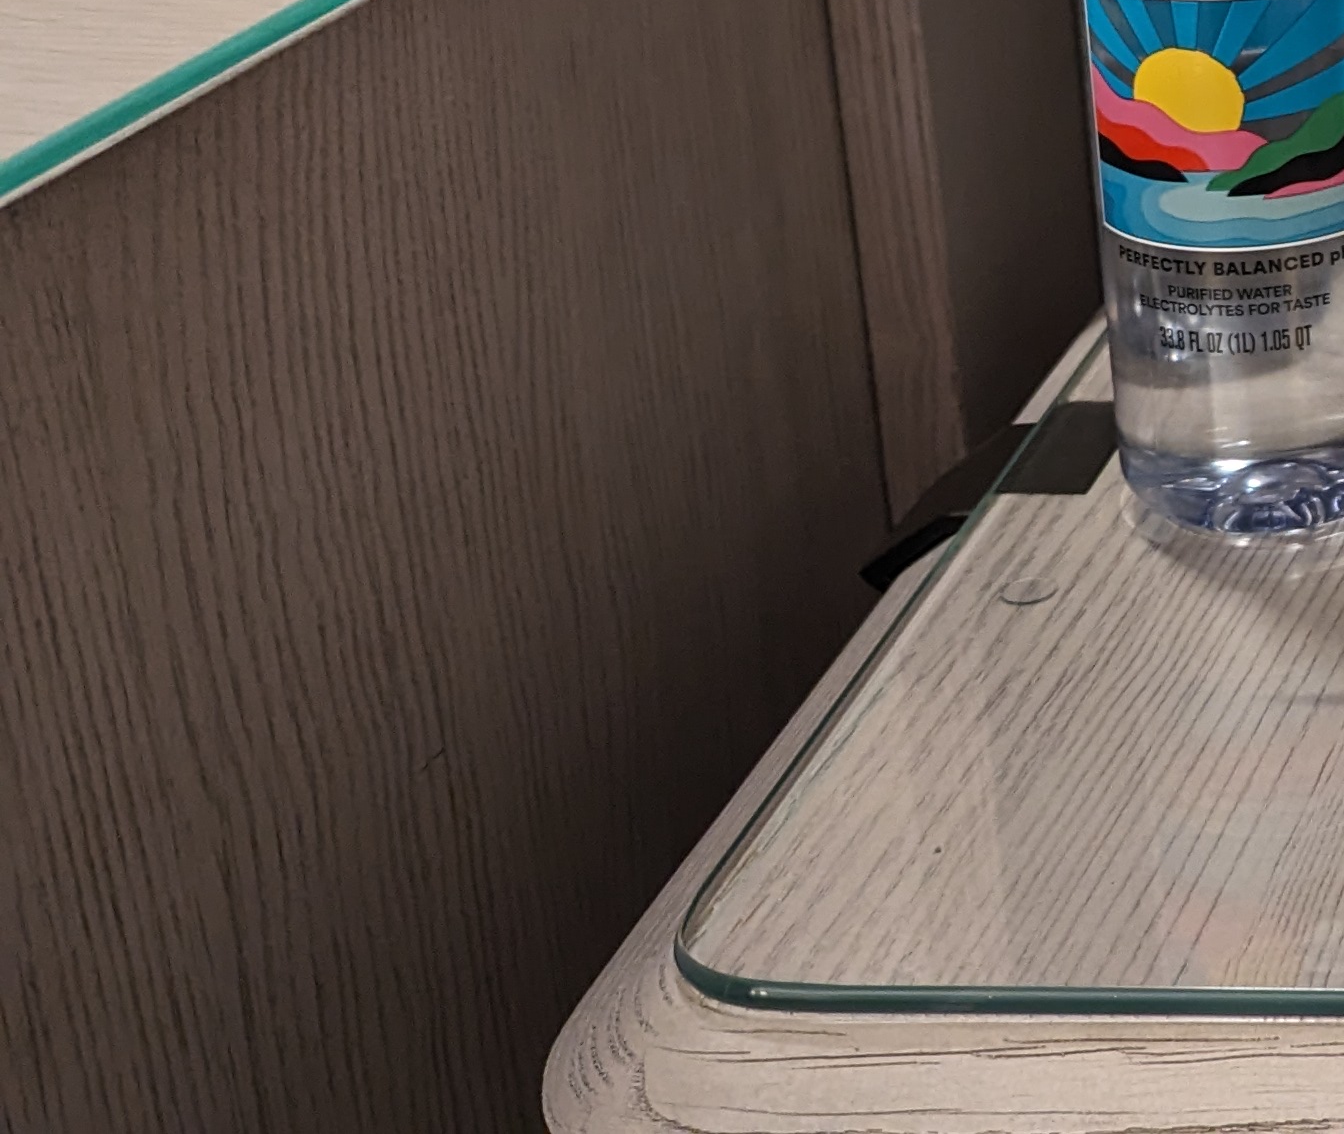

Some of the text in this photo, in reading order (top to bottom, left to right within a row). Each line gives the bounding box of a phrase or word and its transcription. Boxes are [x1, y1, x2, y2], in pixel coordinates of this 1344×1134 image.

[1118, 244, 1207, 277] PERFECTLY
[1213, 251, 1325, 277] BALANCED
[1139, 292, 1331, 317] ELECTROLYTES FOR TASTE
[1167, 283, 1293, 302] PURIFIED WATER
[1159, 324, 1313, 355] 33.8 FL OZ (1L) 1.05 QT
